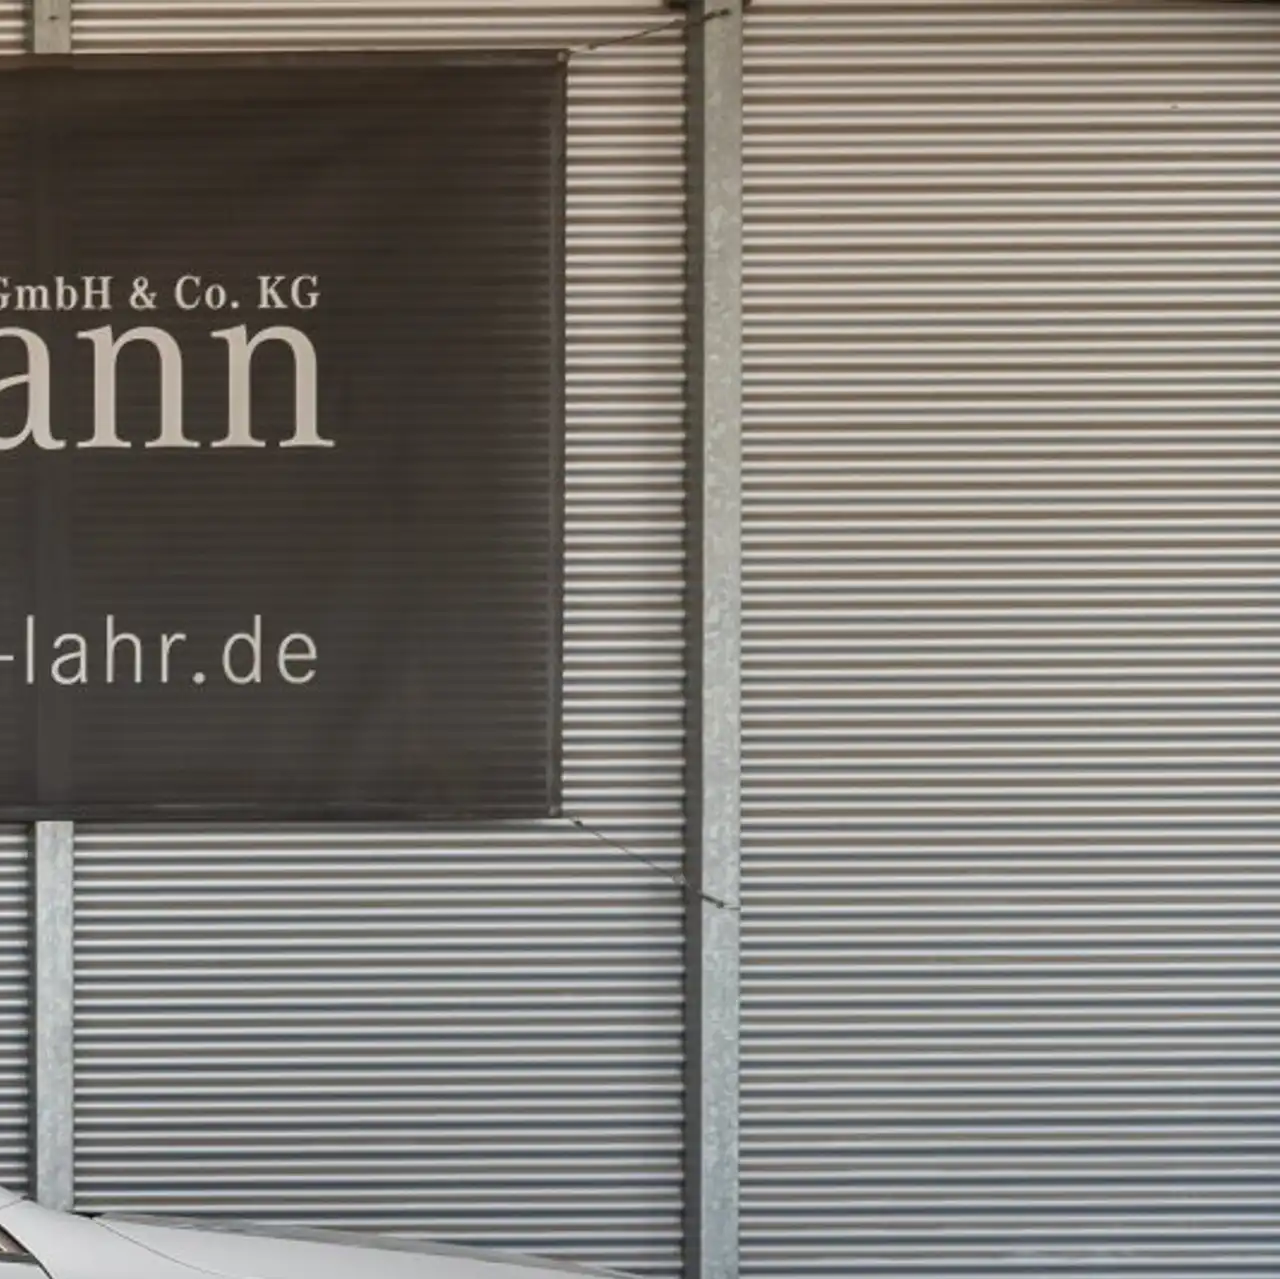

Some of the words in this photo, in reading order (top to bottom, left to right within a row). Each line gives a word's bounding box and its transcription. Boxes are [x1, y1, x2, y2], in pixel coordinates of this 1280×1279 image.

[128, 276, 158, 310] &
[174, 274, 240, 311] Co.
[258, 274, 321, 311] KG
